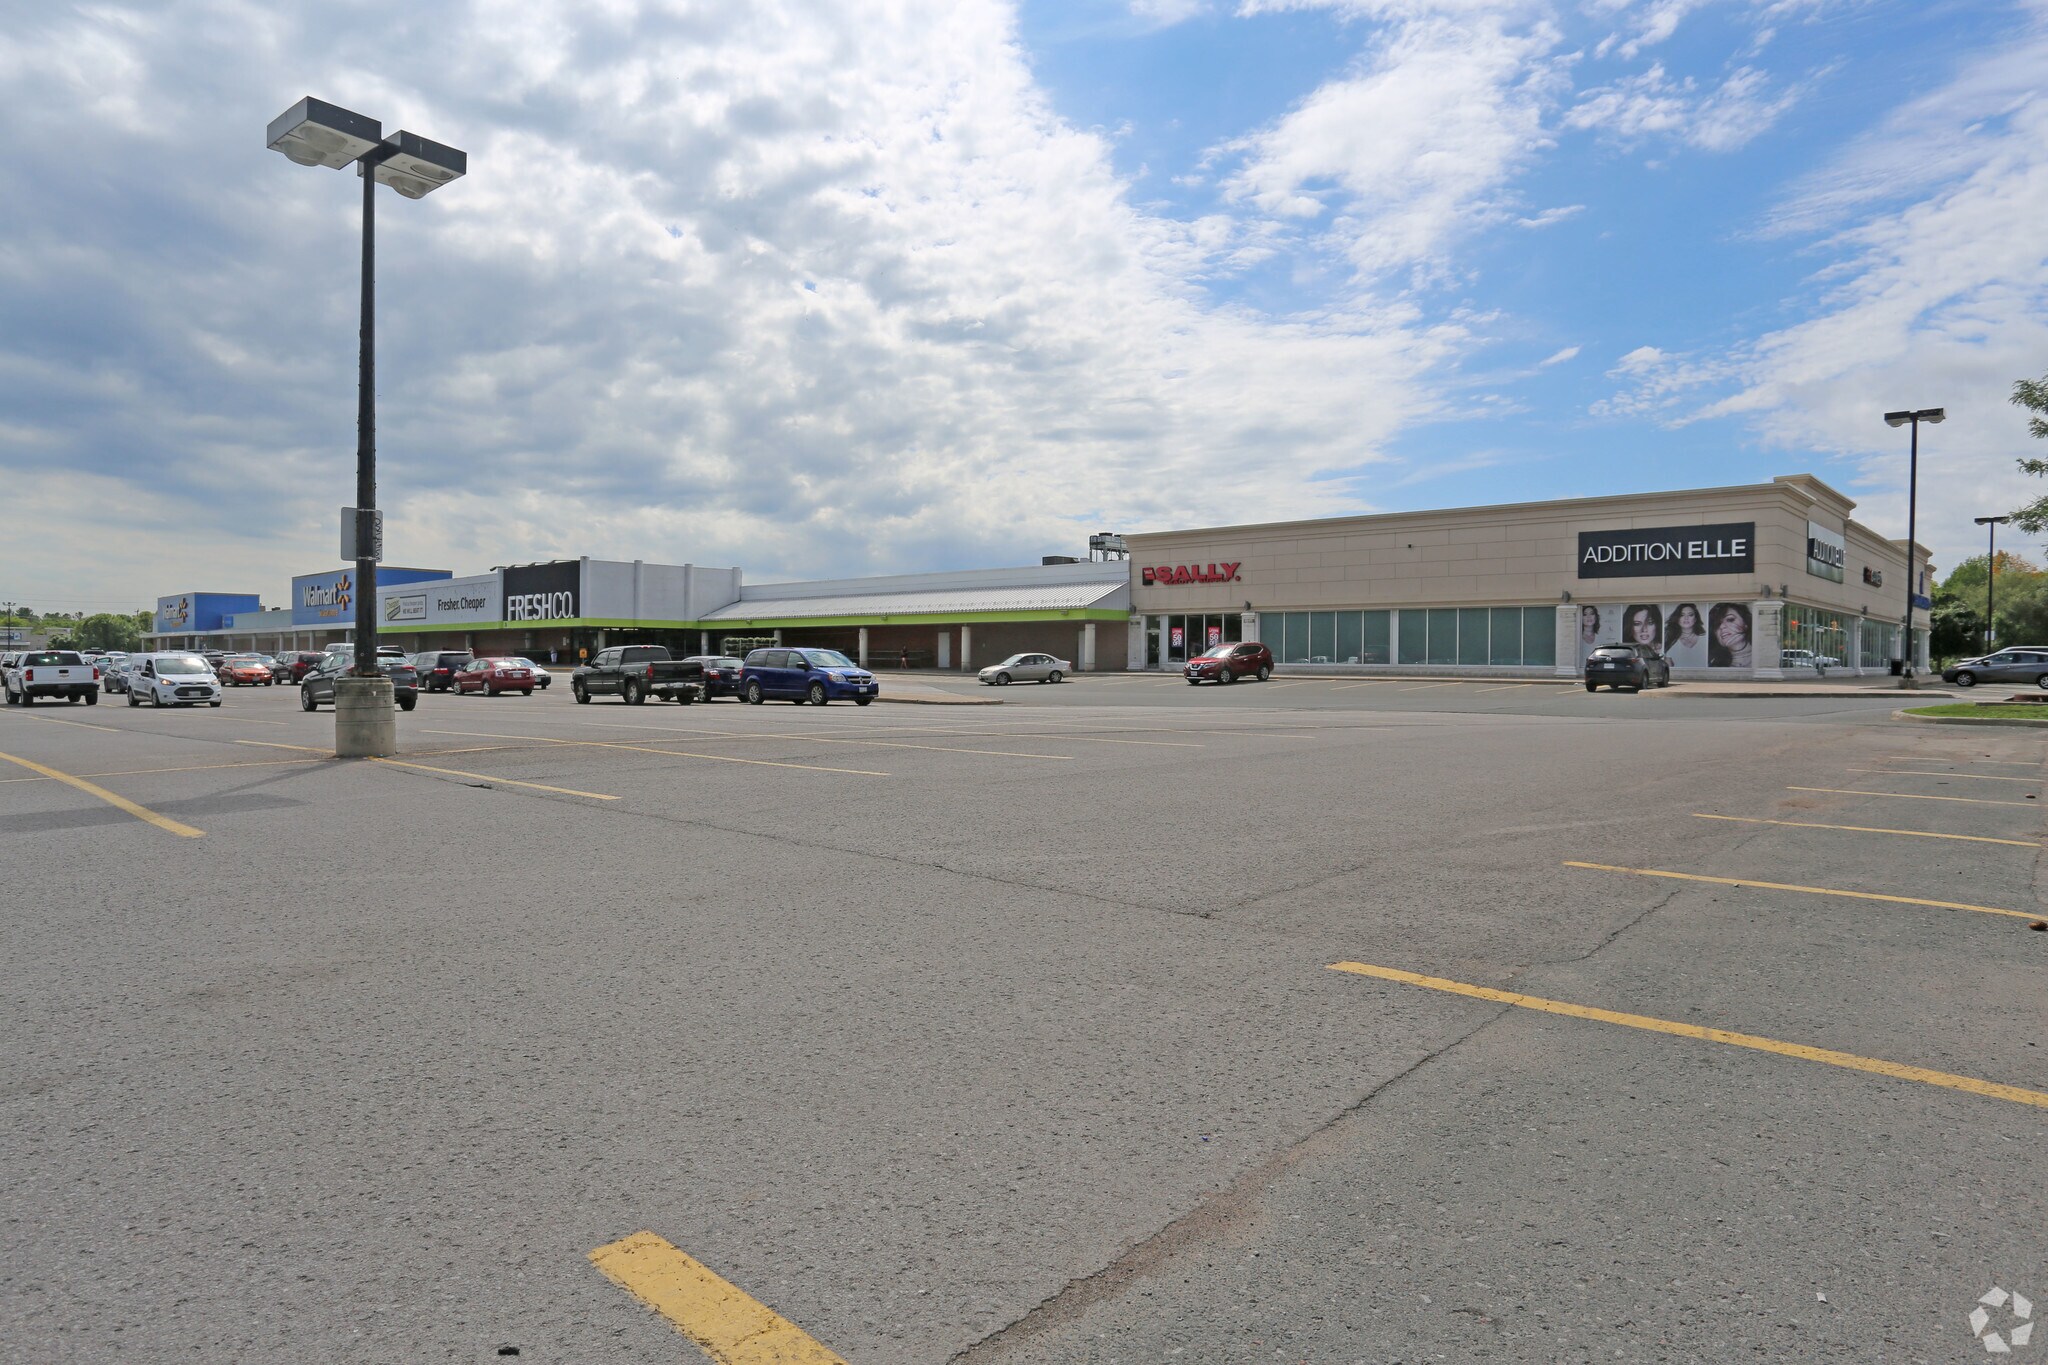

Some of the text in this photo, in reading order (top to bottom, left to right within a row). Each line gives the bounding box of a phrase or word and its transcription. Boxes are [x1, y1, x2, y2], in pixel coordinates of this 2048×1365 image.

[1583, 538, 1747, 564] ADDITION ELLE
[1156, 562, 1241, 582] SALLY
[303, 583, 339, 607] Walmart
[460, 597, 486, 612] Cheaper
